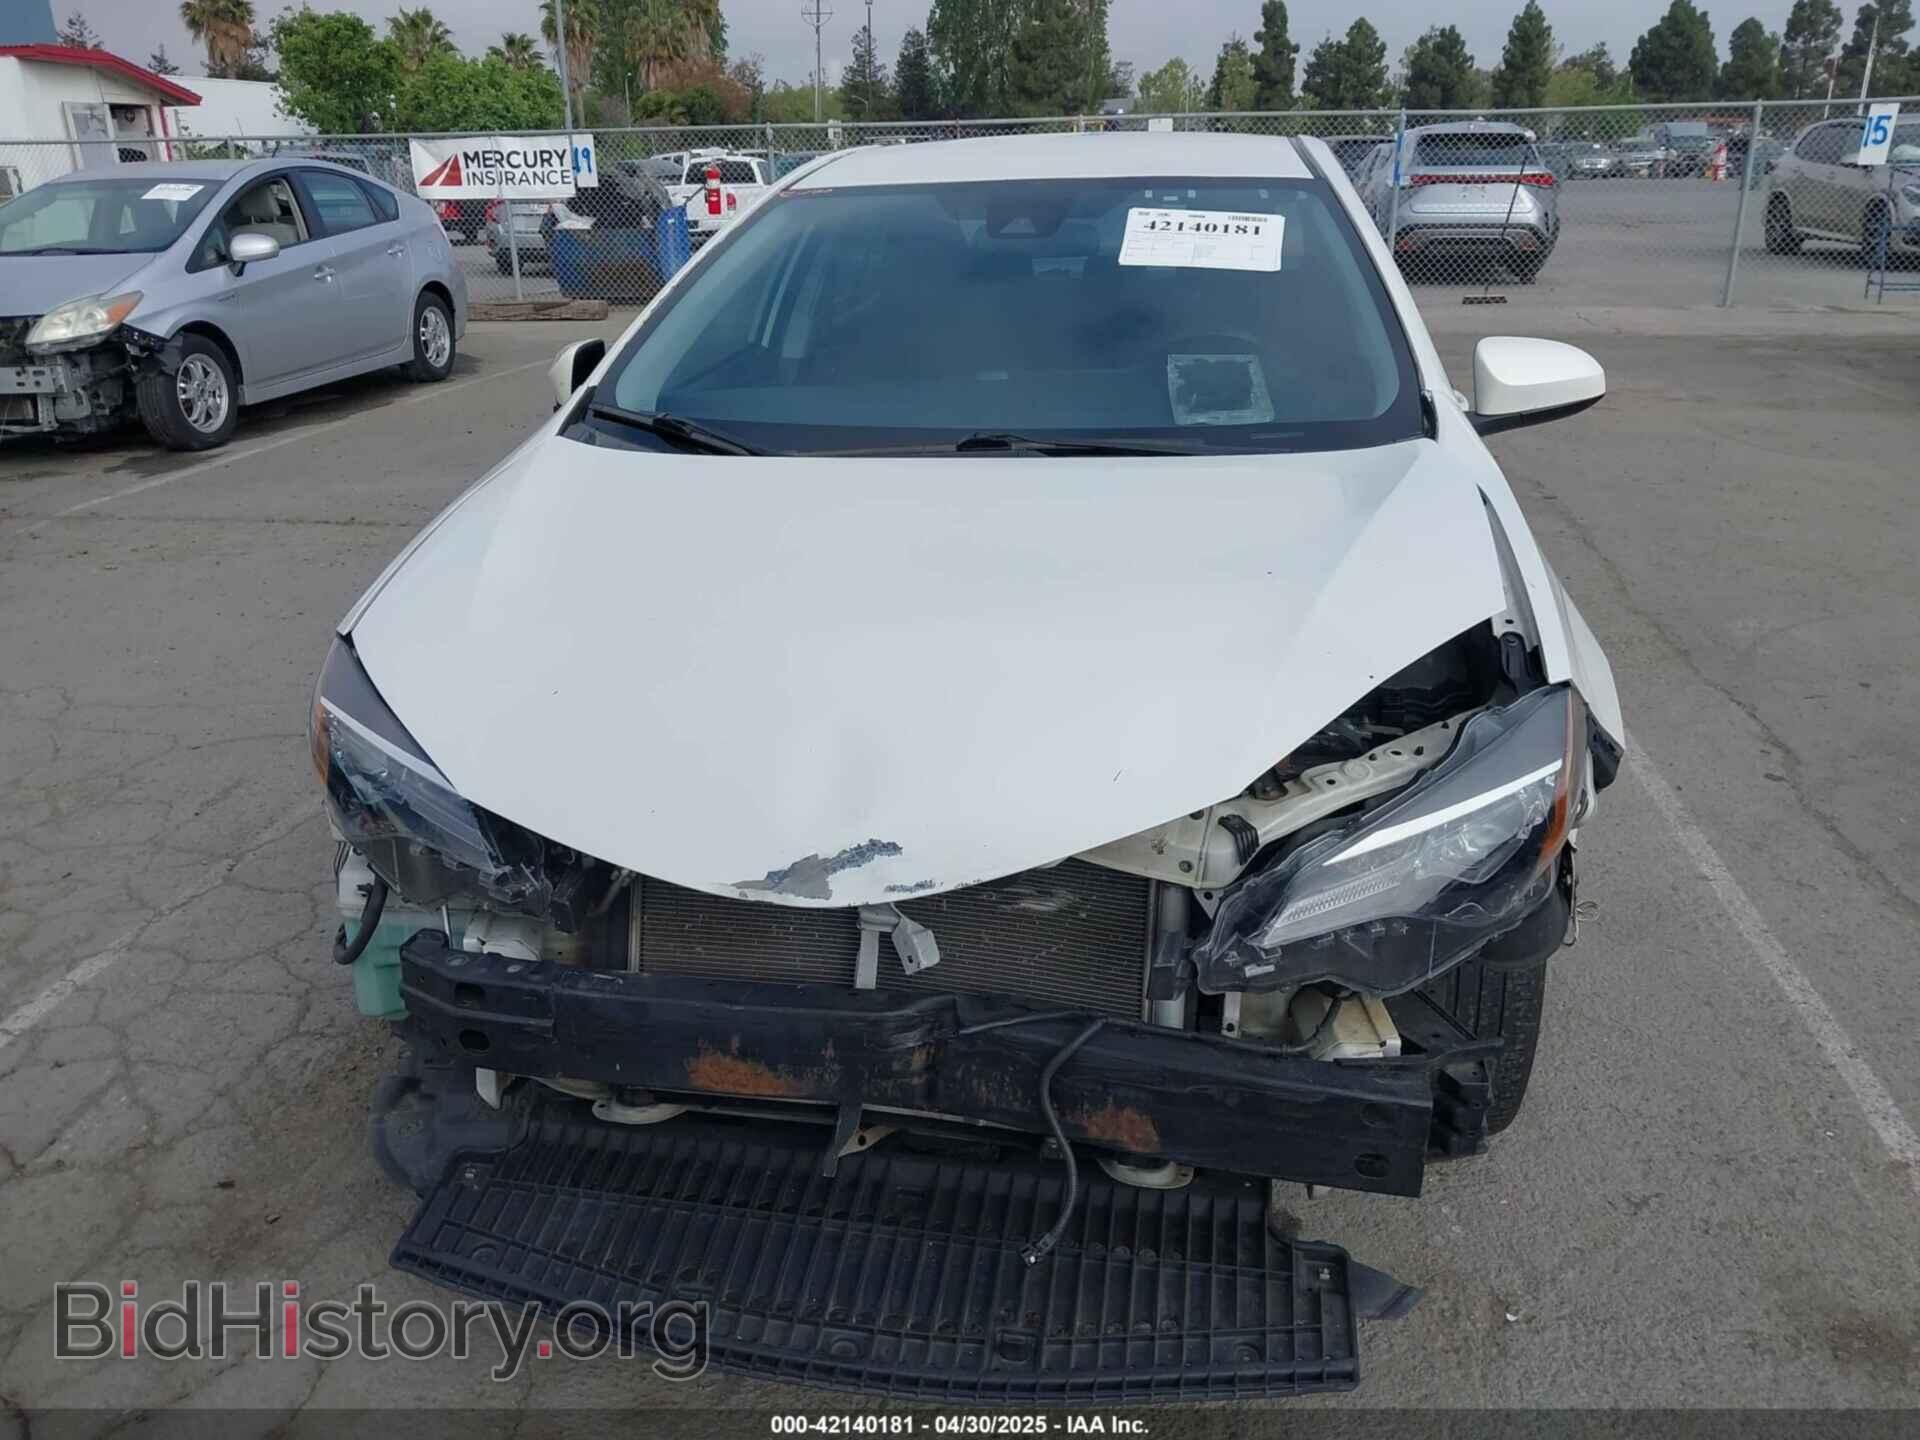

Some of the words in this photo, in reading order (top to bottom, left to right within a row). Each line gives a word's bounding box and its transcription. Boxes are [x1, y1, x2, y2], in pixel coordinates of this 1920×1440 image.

[1863, 115, 1892, 147] 15
[463, 149, 566, 168] MERCURY
[466, 170, 572, 186] INSURANCE
[1144, 220, 1260, 235] 42140181
